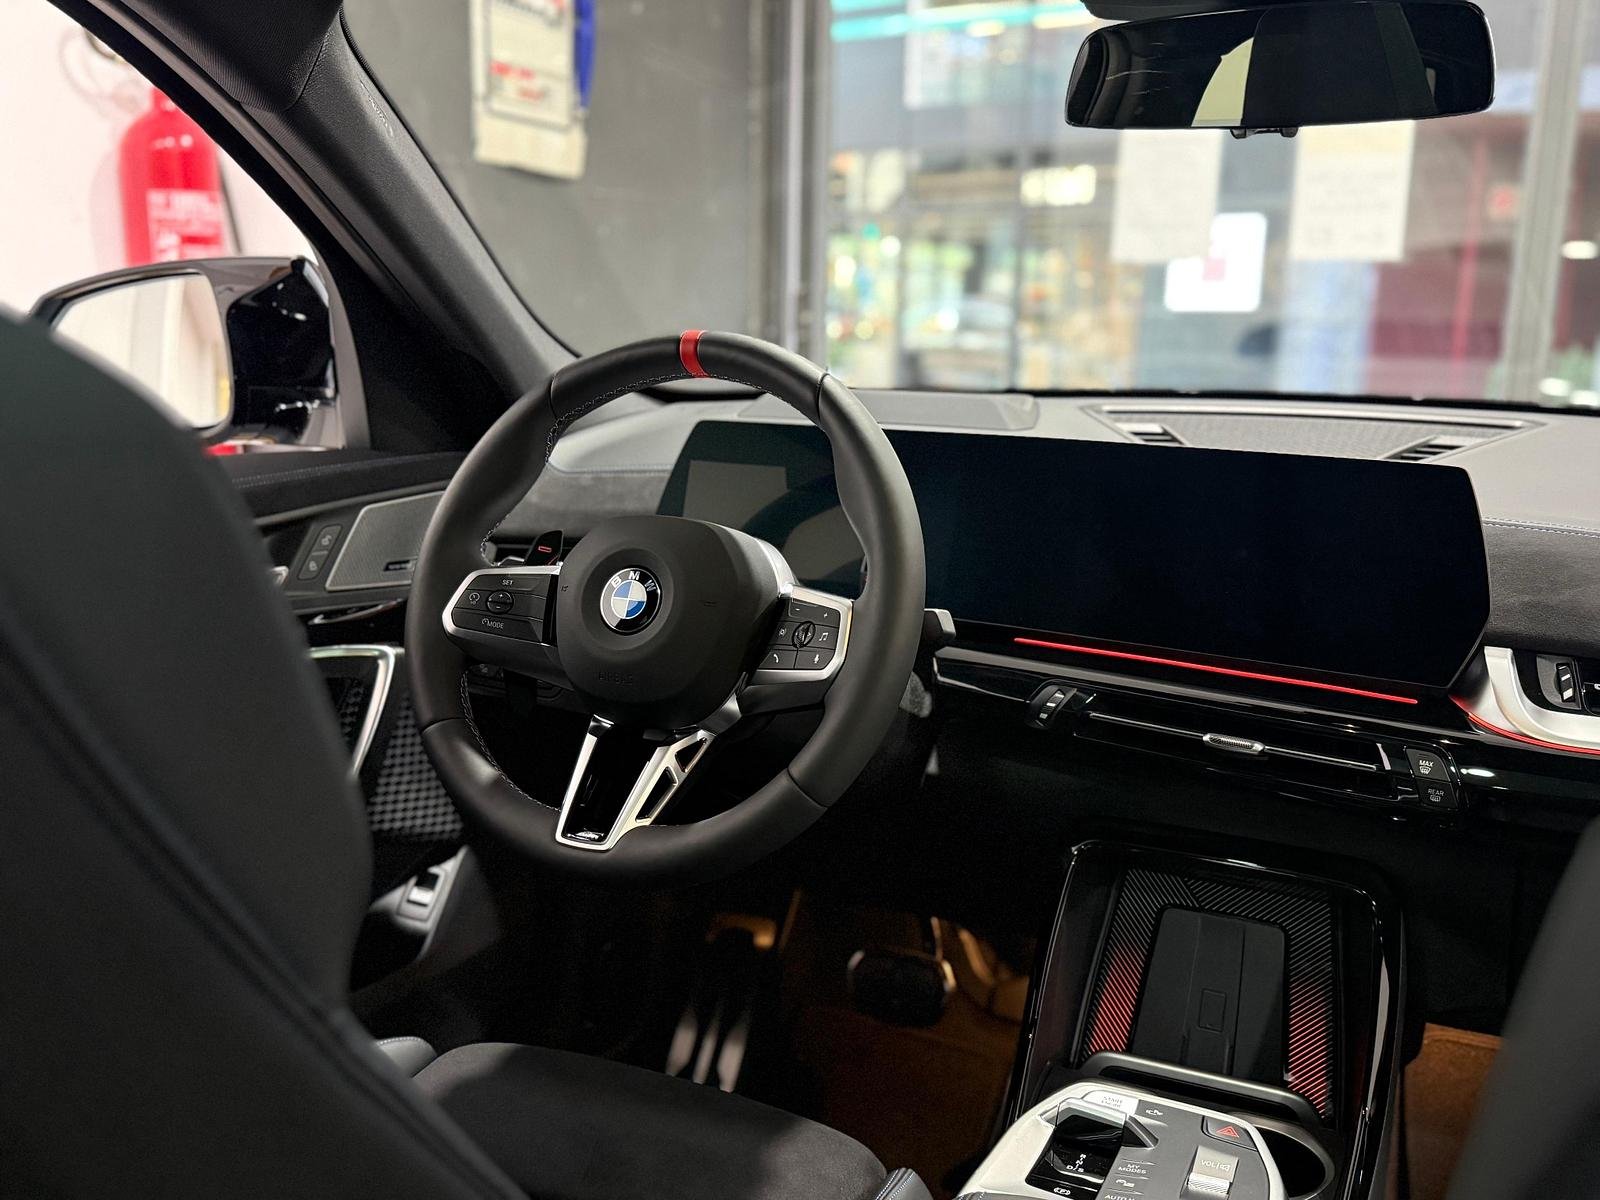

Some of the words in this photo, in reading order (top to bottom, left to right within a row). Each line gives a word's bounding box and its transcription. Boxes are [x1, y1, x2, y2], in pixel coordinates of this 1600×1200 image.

[610, 570, 657, 592] BMW
[487, 621, 504, 629] MODE
[1419, 759, 1434, 767] MAX
[1428, 788, 1444, 796] REAR
[1118, 1166, 1147, 1175] MODES
